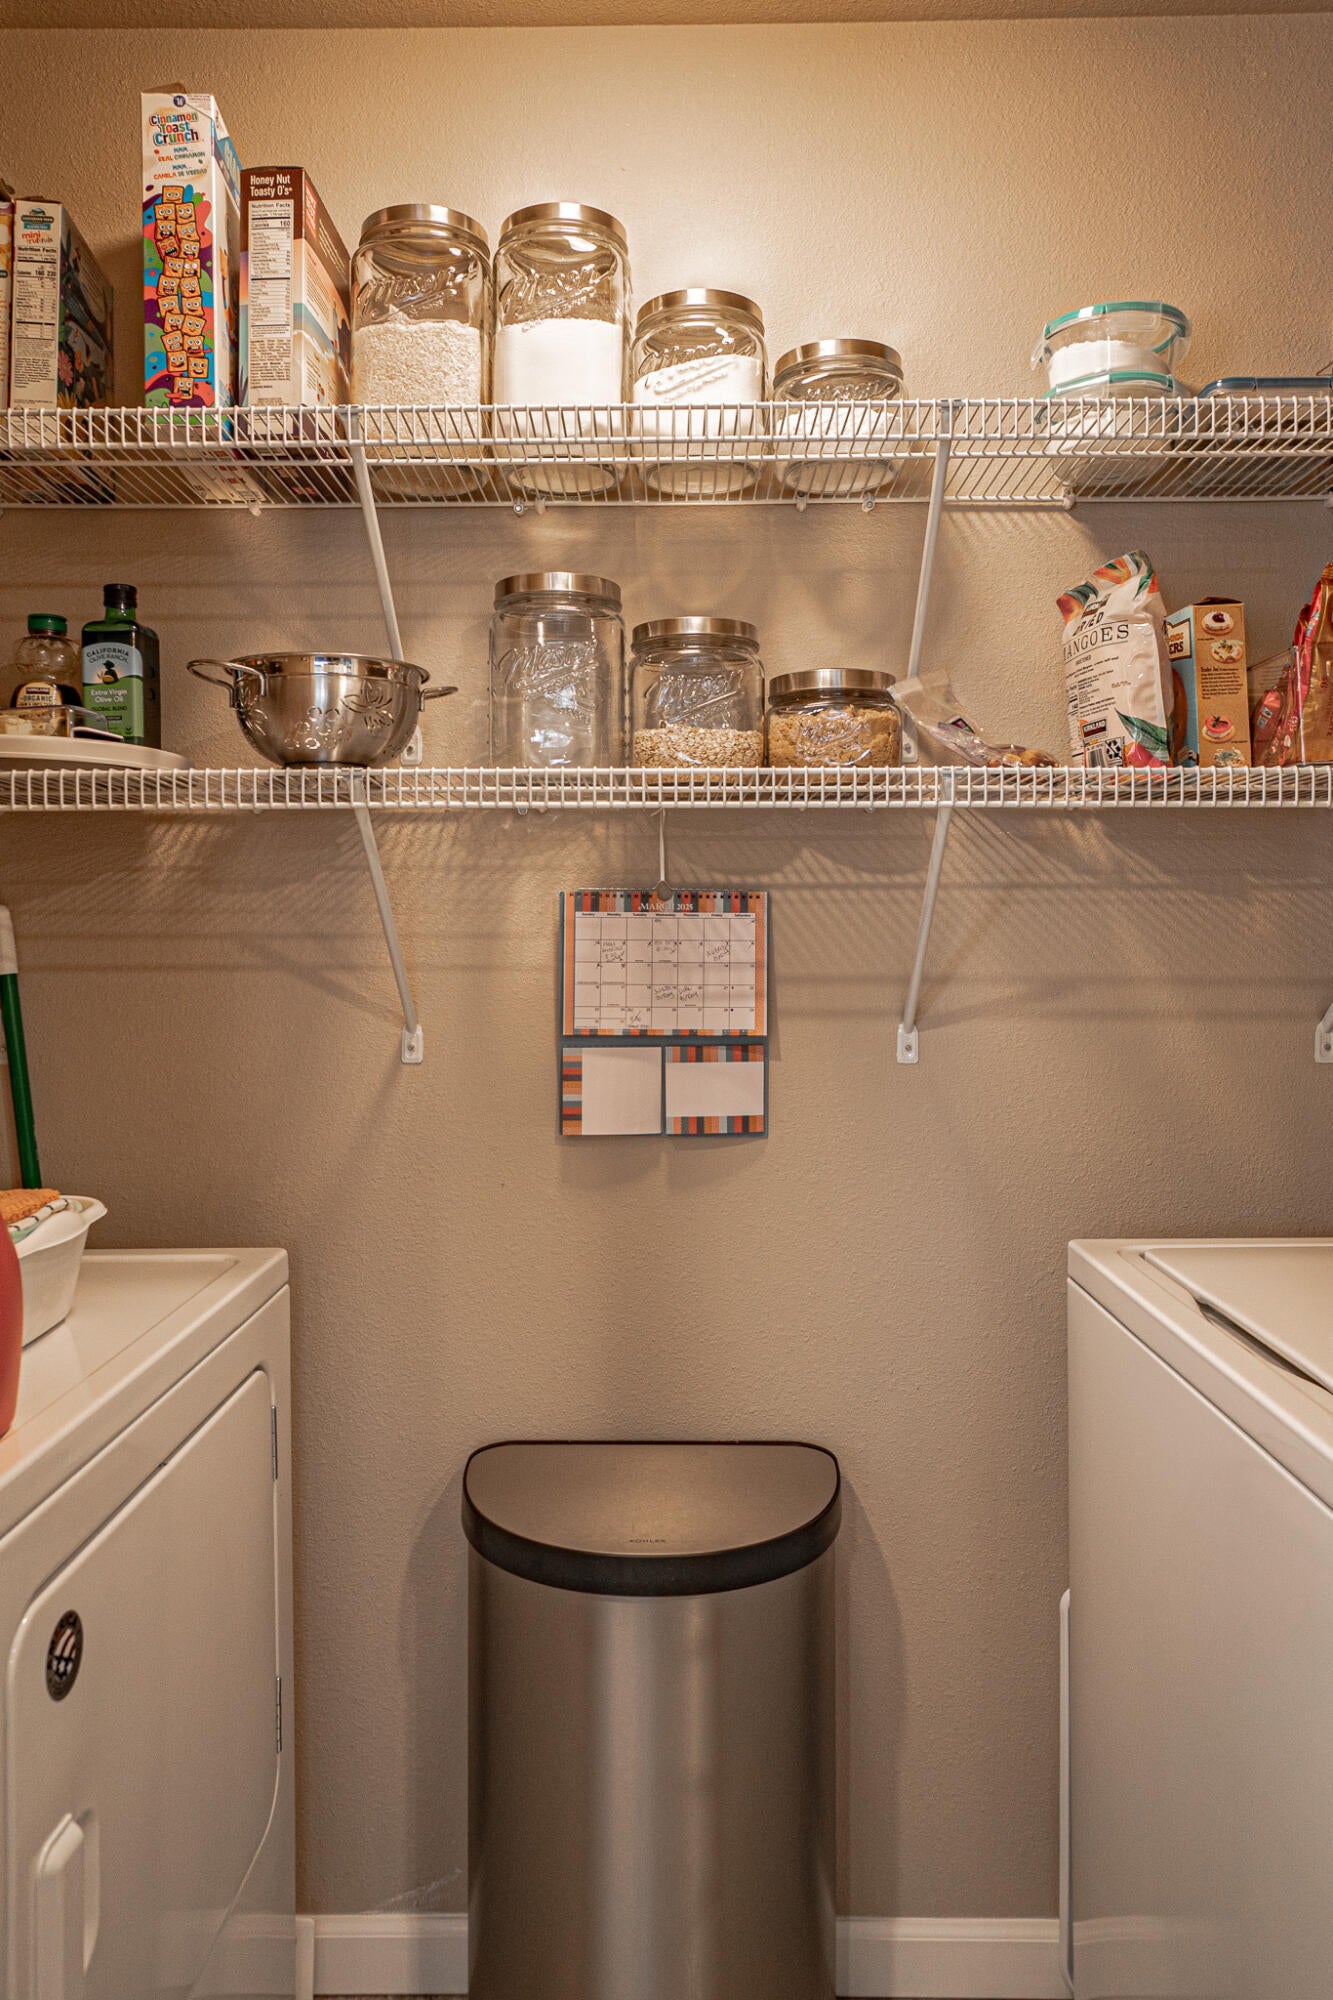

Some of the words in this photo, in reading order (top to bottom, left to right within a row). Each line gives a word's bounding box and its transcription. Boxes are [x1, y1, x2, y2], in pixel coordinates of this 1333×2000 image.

[150, 112, 198, 125] Cinnamon
[160, 122, 190, 134] Toast
[155, 129, 199, 144] Crunch
[250, 175, 274, 186] Honey
[276, 174, 290, 184] Nut
[250, 186, 275, 198] Toasty
[22, 231, 40, 239] mini
[86, 648, 129, 658] CALIFORNIA
[108, 689, 127, 697] Virgin
